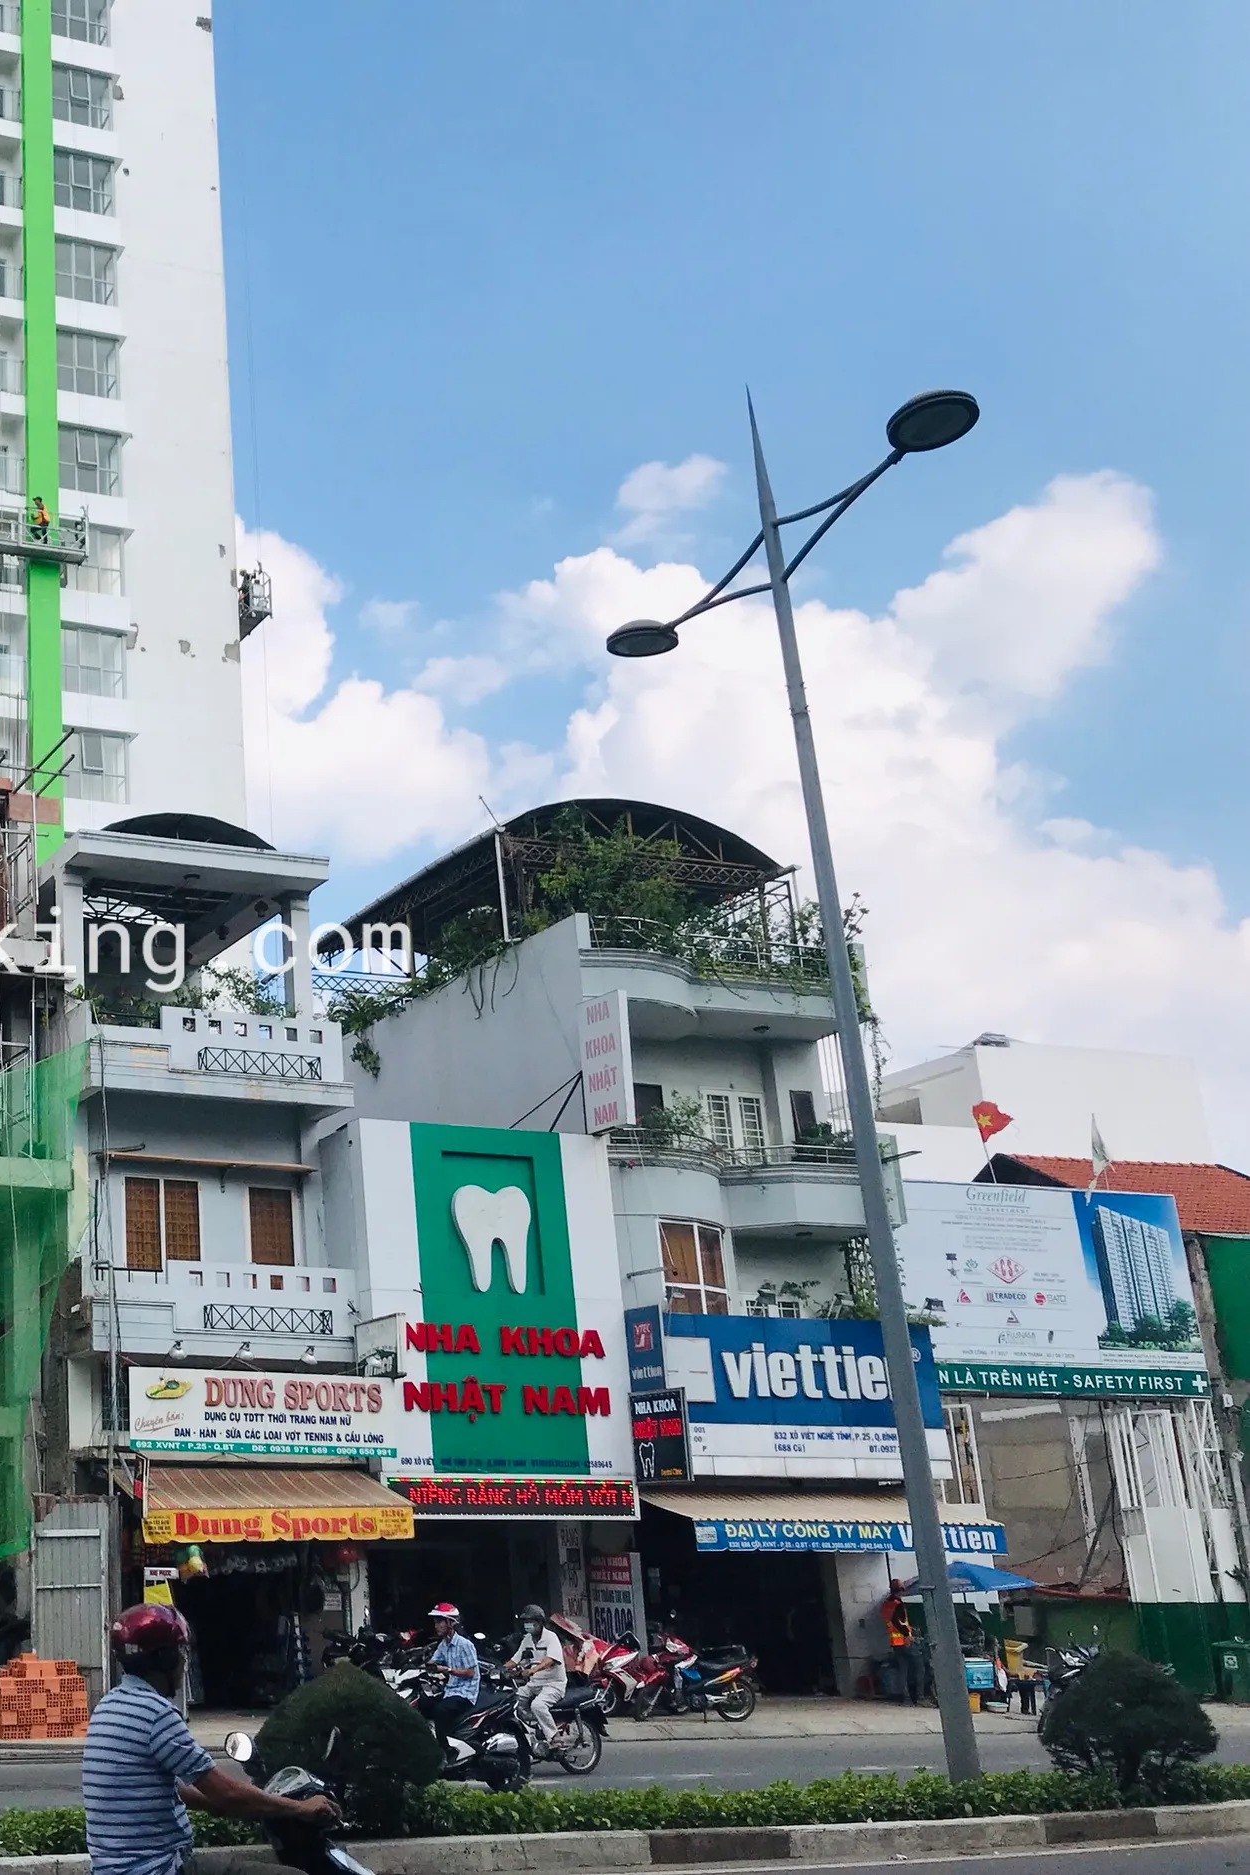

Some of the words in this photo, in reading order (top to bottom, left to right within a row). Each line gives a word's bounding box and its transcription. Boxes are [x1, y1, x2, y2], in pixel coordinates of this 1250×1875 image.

[586, 1001, 610, 1025] NHA
[585, 1033, 616, 1060] KHOA
[588, 1064, 618, 1093] NHẬT
[593, 1101, 618, 1126] NAM
[966, 1185, 1027, 1203] Greenfield
[406, 1321, 481, 1354] NHA
[501, 1325, 607, 1359] KHOA
[721, 1342, 893, 1401] viettie
[954, 1367, 976, 1385] LÀ
[978, 1369, 1022, 1386] TRÊN
[1073, 1375, 1134, 1389] SAFETY
[1138, 1376, 1183, 1391] FIRST
[204, 1377, 276, 1409] DUNG
[284, 1380, 383, 1413] SPORTS
[404, 1375, 507, 1422] NHẬT
[523, 1384, 611, 1416] NAM
[635, 1402, 653, 1414] NHA
[653, 1398, 677, 1412] KHOA
[204, 1412, 226, 1423] DỤNG
[229, 1412, 241, 1423] CỤ
[244, 1413, 264, 1422] TDTT
[290, 1414, 317, 1424] TRANG
[319, 1416, 337, 1425] NAM
[174, 1428, 191, 1437] ĐAN
[199, 1427, 216, 1438] HÀN
[225, 1427, 241, 1439] SỬA
[244, 1428, 261, 1439] CÁC
[264, 1431, 282, 1442] LOẠI
[305, 1432, 333, 1442] TENNIS
[336, 1433, 341, 1441] &
[774, 1432, 787, 1440] 832
[136, 1441, 153, 1449] 692
[188, 1442, 207, 1450] P.25
[214, 1443, 235, 1451] Q.BT
[294, 1445, 309, 1454] 971
[174, 1511, 264, 1539] Dung
[271, 1510, 378, 1539] Sports
[725, 1524, 754, 1541] ĐẠI
[757, 1521, 777, 1537] LÝ
[782, 1521, 830, 1539] CÔNG
[833, 1525, 853, 1539] TY
[857, 1526, 893, 1540] MAY
[897, 1525, 997, 1550] Vttien
[607, 1556, 628, 1567] KHOA
[612, 1571, 630, 1581] NAM
